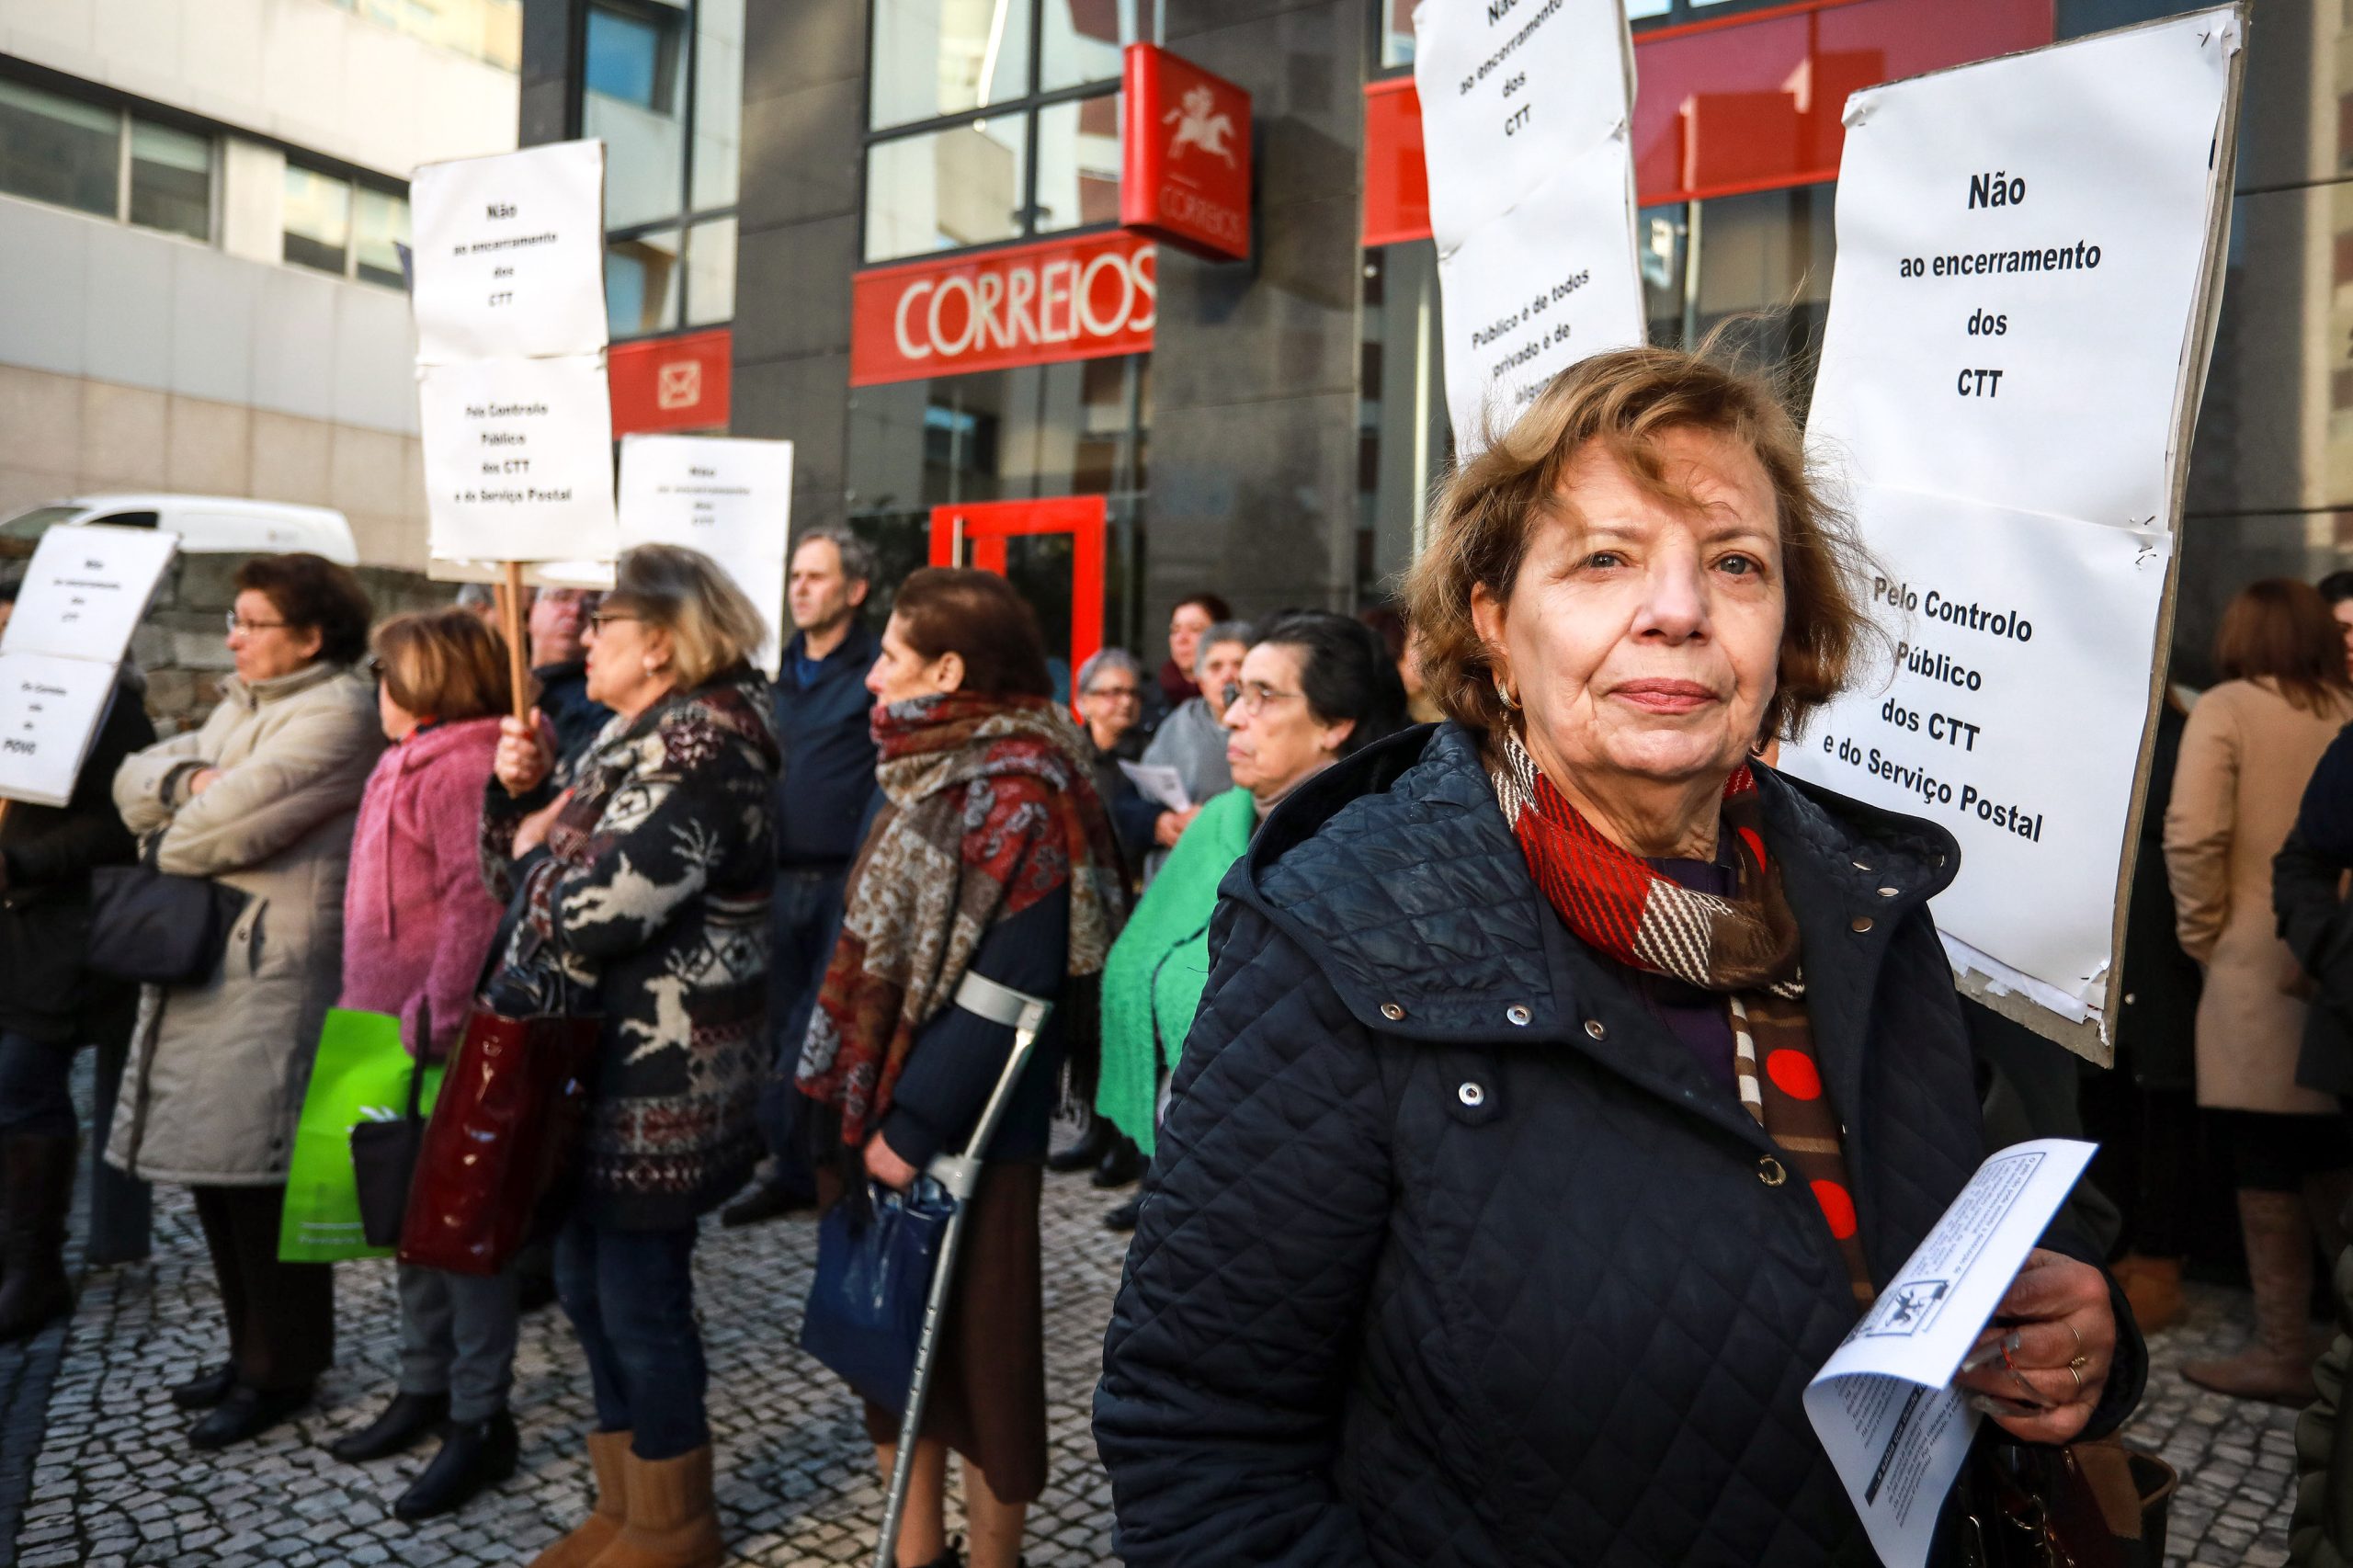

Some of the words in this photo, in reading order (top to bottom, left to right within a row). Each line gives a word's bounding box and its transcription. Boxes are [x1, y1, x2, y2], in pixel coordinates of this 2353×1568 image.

[1460, 74, 1473, 96] ao
[1477, 0, 1563, 79] encerramento
[1503, 71, 1526, 97] dos
[1505, 103, 1530, 136] CTT
[487, 204, 517, 221] Não
[1159, 185, 1243, 244] CORREIOS
[1968, 170, 2026, 210] Não
[1900, 257, 1925, 278] ao
[1932, 240, 2101, 277] encerramento
[894, 244, 1157, 359] CORREIOS
[1472, 312, 1518, 349] Público
[1533, 295, 1548, 314] de
[1552, 269, 1589, 301] todos
[1967, 308, 2007, 335] dos
[1493, 341, 1539, 381] privado
[1554, 323, 1570, 343] de
[1958, 369, 2003, 397] CTT
[504, 459, 529, 473] CTT
[1873, 576, 1917, 611] Pelo
[1925, 591, 2032, 642] Controlo
[1897, 642, 1982, 691] Público
[1881, 698, 1919, 732] dos
[1928, 712, 1980, 752] CTT
[1824, 734, 1834, 753] e
[1839, 738, 1861, 767] do
[1868, 748, 1952, 804] Serviço
[1960, 784, 2043, 843] Postal
